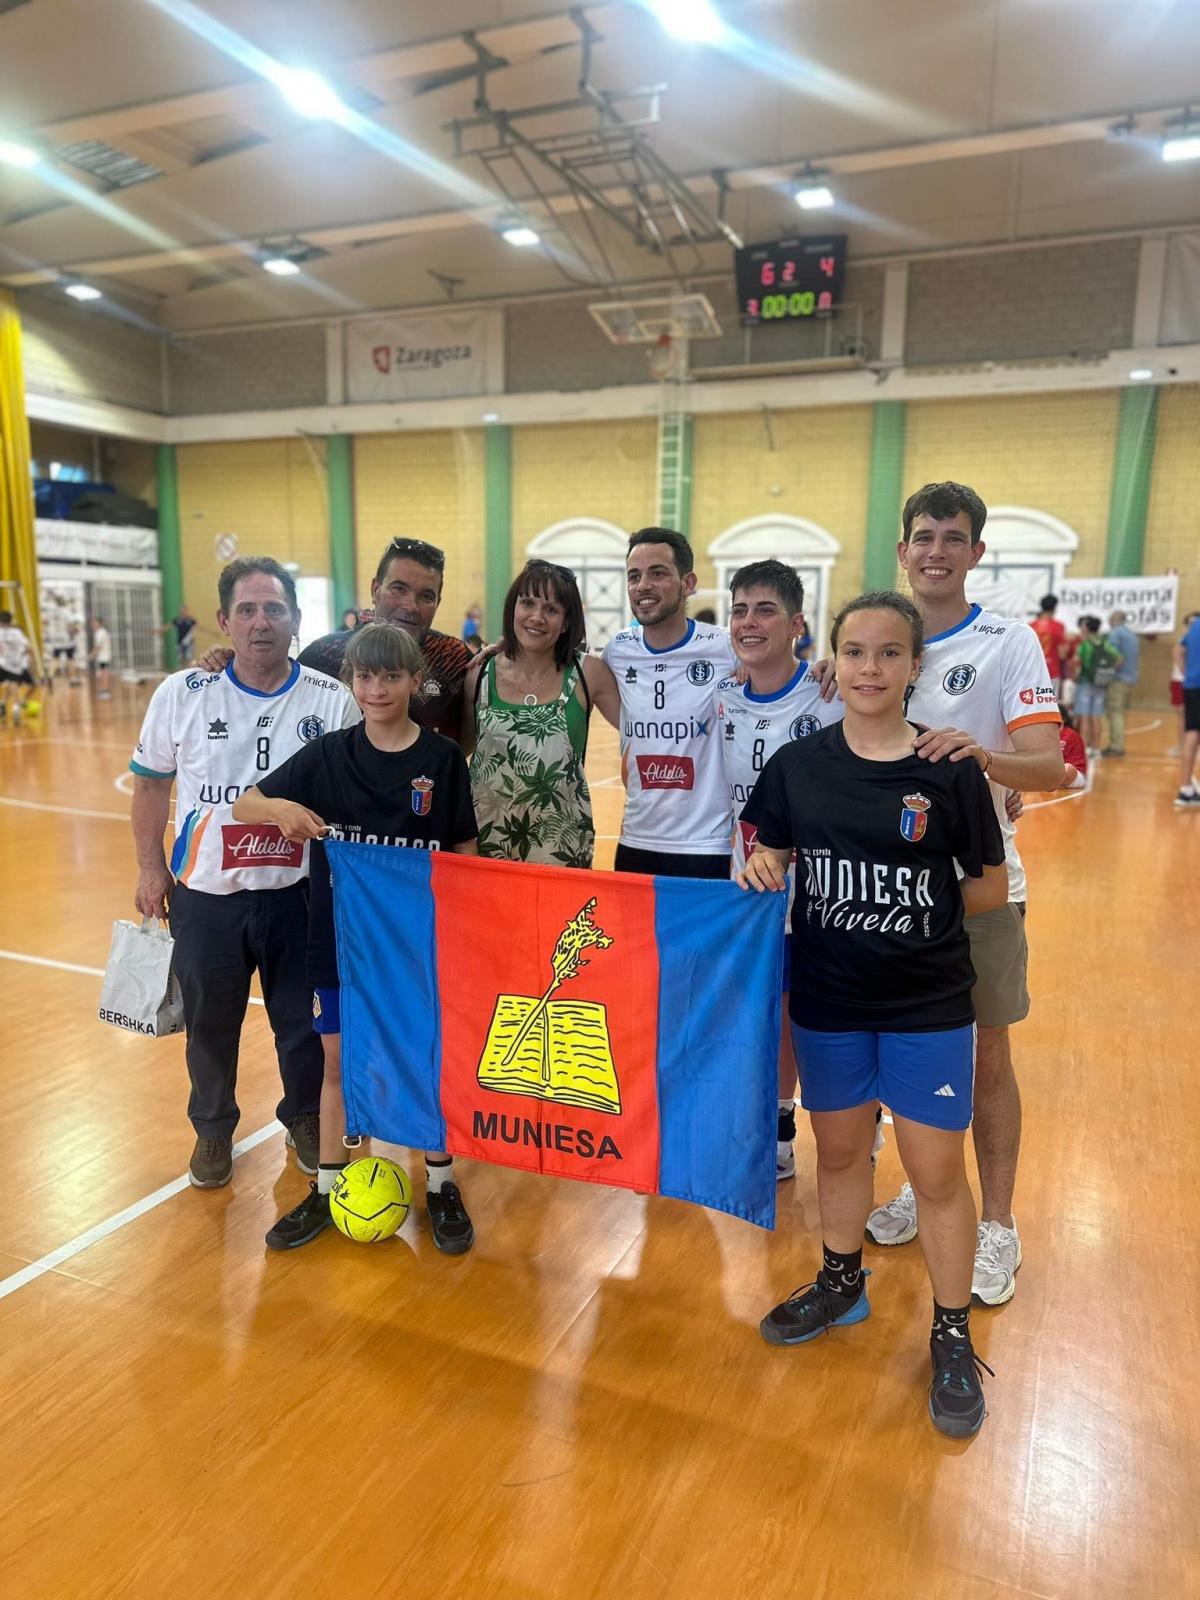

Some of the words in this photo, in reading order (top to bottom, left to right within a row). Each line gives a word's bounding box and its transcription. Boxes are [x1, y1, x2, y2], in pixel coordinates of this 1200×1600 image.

[761, 261, 775, 286] 6
[782, 260, 796, 281] 2
[762, 292, 815, 318] 00:00
[396, 345, 471, 369] Zaragoza
[1060, 586, 1173, 608] tapigrama
[1125, 607, 1171, 624] ofás
[304, 675, 339, 691] mique
[654, 680, 665, 710] 8
[256, 737, 270, 771] 8
[752, 738, 765, 771] 8
[99, 1008, 156, 1036] BERSHKA
[472, 1110, 623, 1160] MUNIESA
